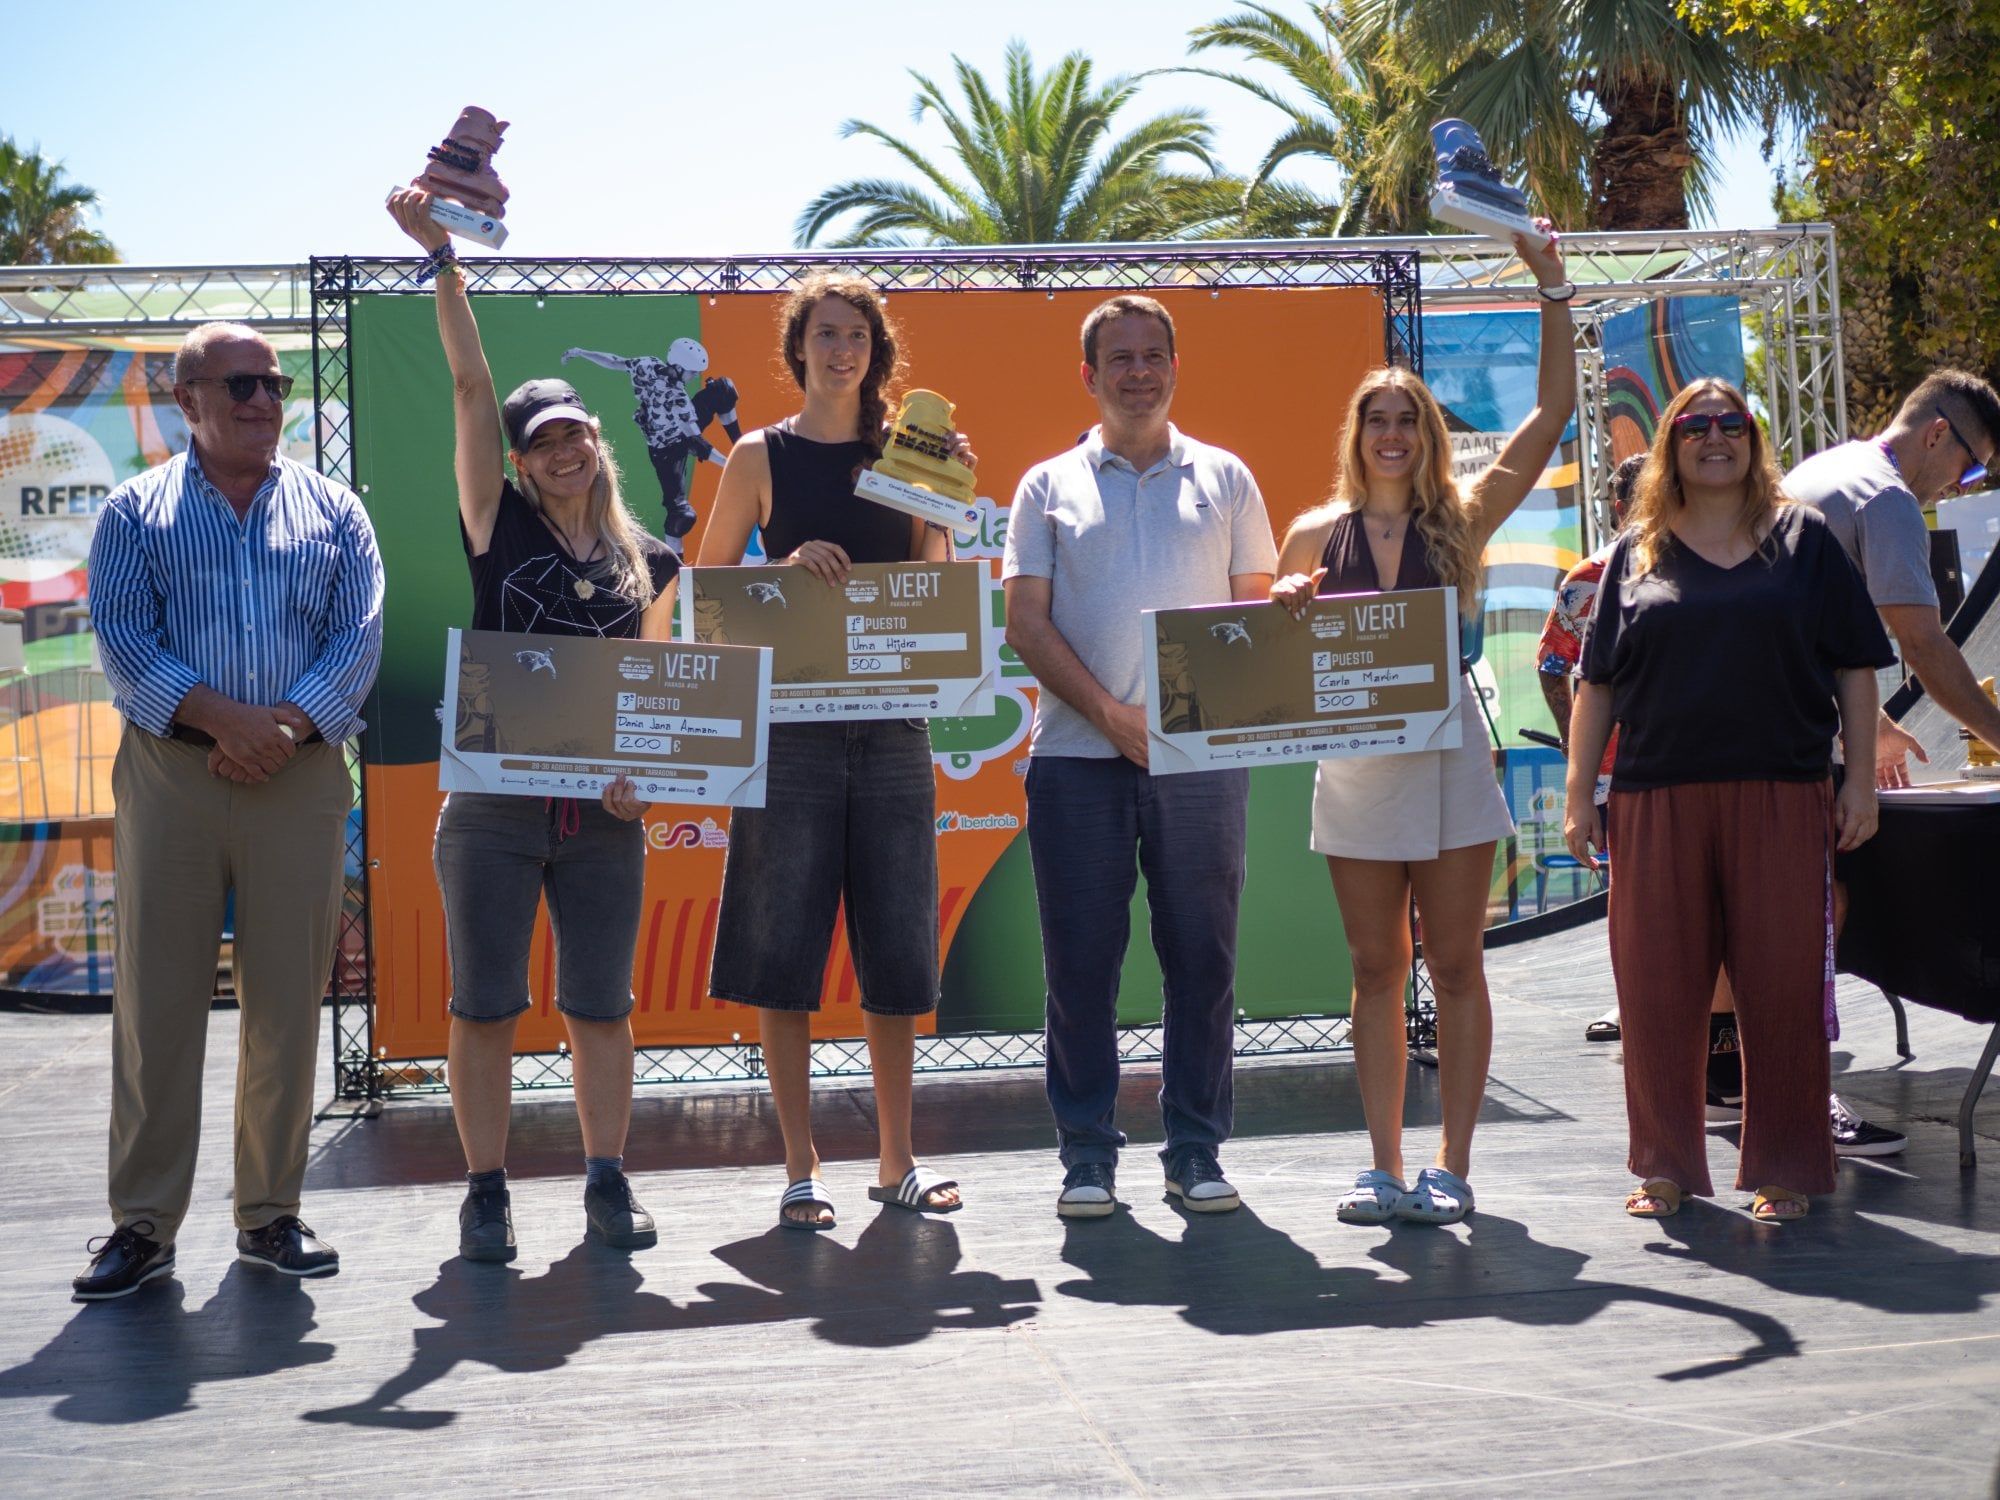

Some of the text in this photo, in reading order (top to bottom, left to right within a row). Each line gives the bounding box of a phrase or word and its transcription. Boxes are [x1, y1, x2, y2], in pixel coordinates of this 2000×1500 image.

[888, 572, 941, 598] VERT
[865, 617, 907, 630] PUESTO
[1354, 602, 1408, 632] VERT
[852, 637, 876, 650] Uma
[850, 658, 881, 671] 500
[1332, 651, 1374, 666] PUESTO
[665, 652, 720, 681] VERT
[1319, 675, 1350, 687] Carla
[636, 696, 681, 711] PUESTO
[1318, 695, 1355, 708] 300
[649, 718, 671, 730] Jana
[680, 719, 718, 734] Ammann
[620, 737, 661, 749] 200
[960, 814, 1018, 829] Iberdrola
